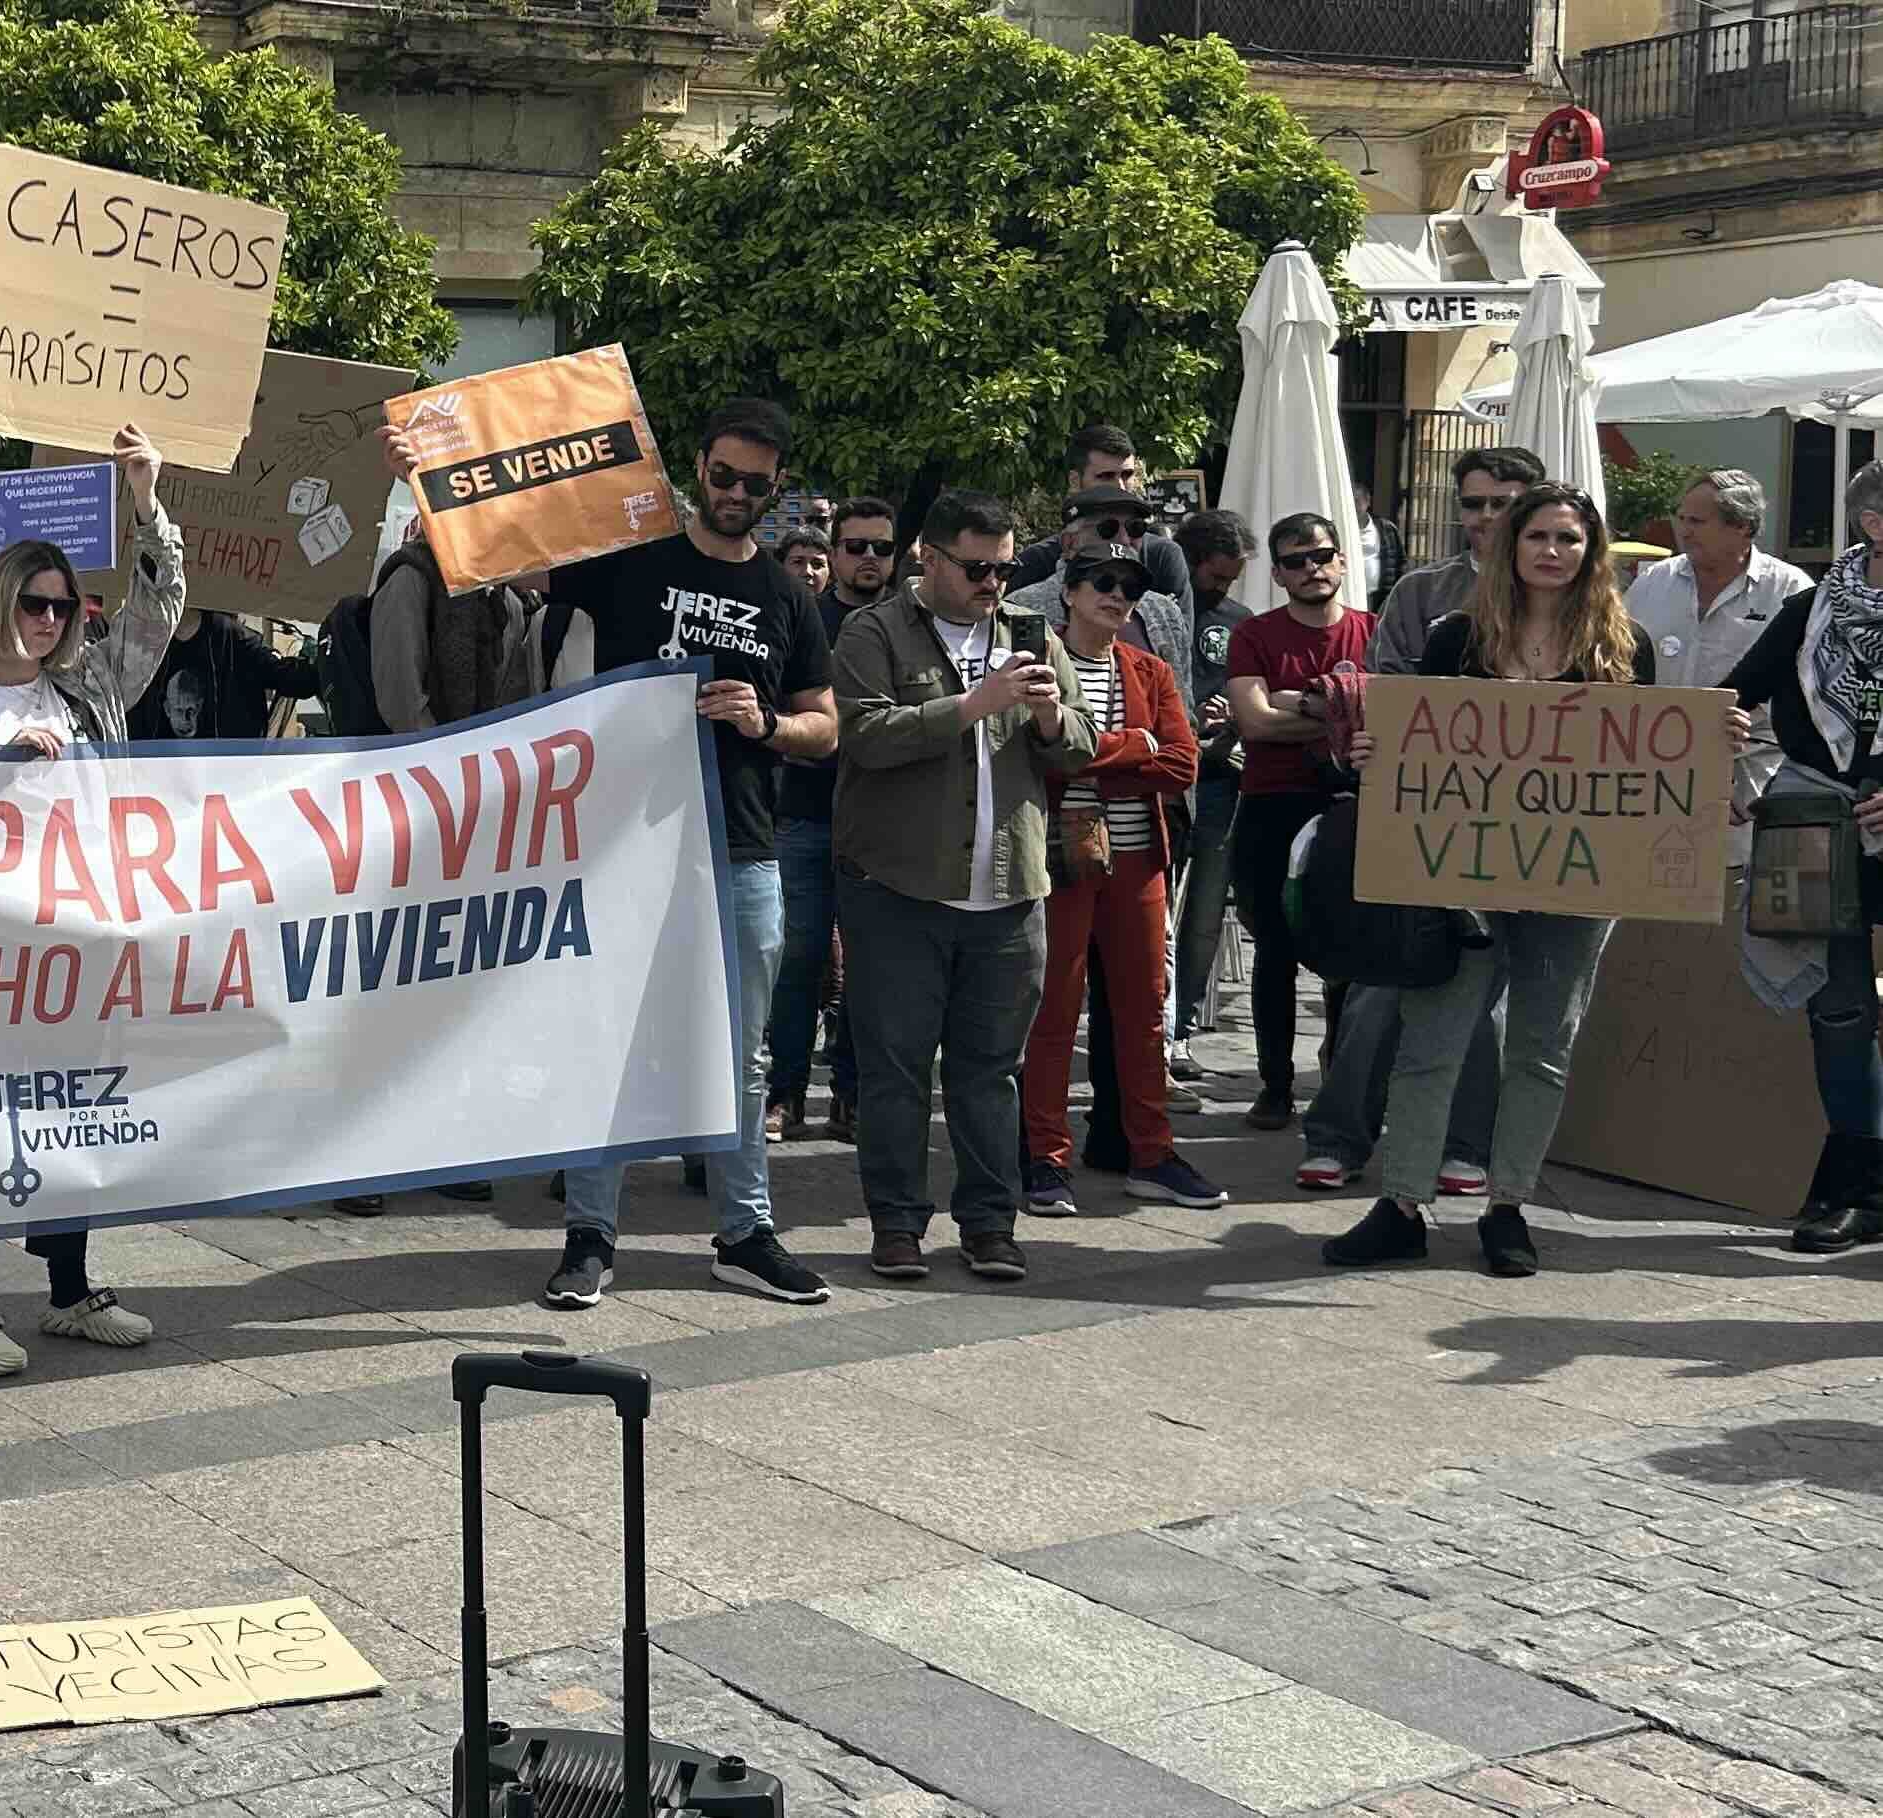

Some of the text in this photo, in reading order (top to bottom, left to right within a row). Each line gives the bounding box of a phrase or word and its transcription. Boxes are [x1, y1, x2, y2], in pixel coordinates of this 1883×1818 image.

[1526, 167, 1591, 185] Cruzcampo
[8, 180, 274, 289] CASEROS
[1405, 297, 1477, 321] CAFE
[1485, 309, 1520, 321] Desde
[24, 470, 96, 484] SUPERVIVENCIA
[448, 464, 497, 498] SE
[502, 434, 614, 483] VENDE
[5, 484, 74, 499] QUE NECESITAS
[660, 586, 761, 630] JEREZ
[714, 622, 756, 638] POR LA
[680, 623, 769, 660] VIVIENDA
[1400, 687, 1693, 764] AQUÍ NO
[1395, 761, 1694, 817] HAY QUIEN
[289, 729, 593, 894] VIVIR
[1414, 821, 1599, 887] VIVA
[98, 938, 140, 1021] A
[170, 928, 255, 1016] LA
[279, 877, 591, 1004] VIVIENDA
[21, 1120, 158, 1152] VIVIENDA
[70, 1108, 130, 1121] POR LA
[6, 1648, 327, 1704] VECINAS
